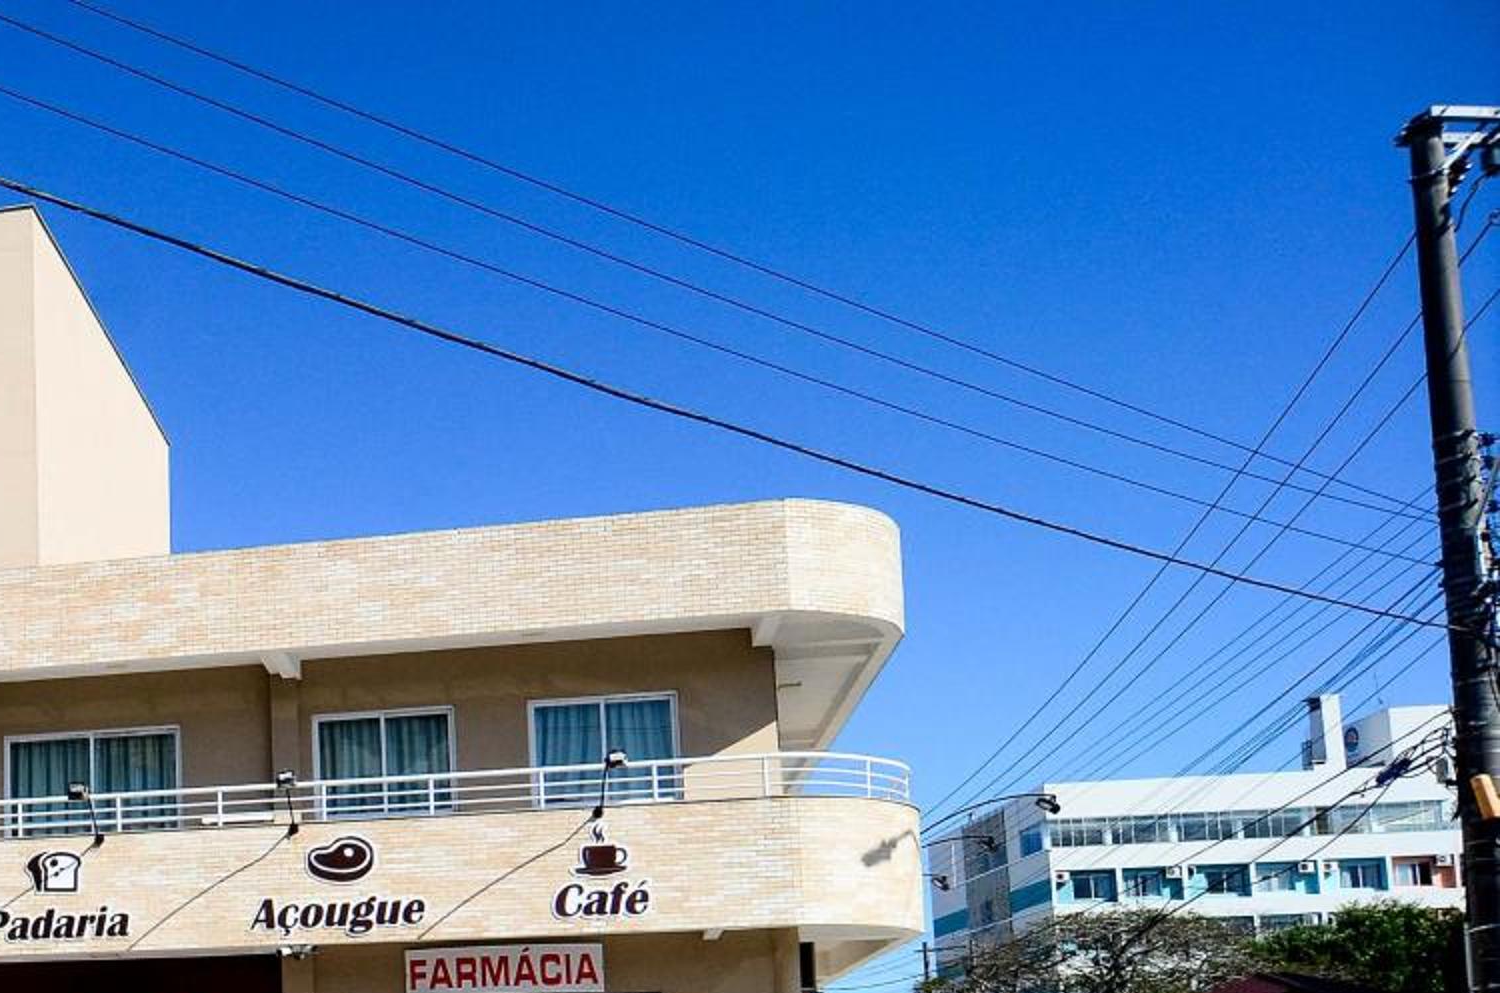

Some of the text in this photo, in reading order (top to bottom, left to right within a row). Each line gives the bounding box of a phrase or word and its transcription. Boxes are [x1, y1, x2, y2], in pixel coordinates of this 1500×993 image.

[251, 895, 426, 936] Açougue
[554, 880, 650, 918] Café
[409, 946, 599, 991] FARMÁCIA
